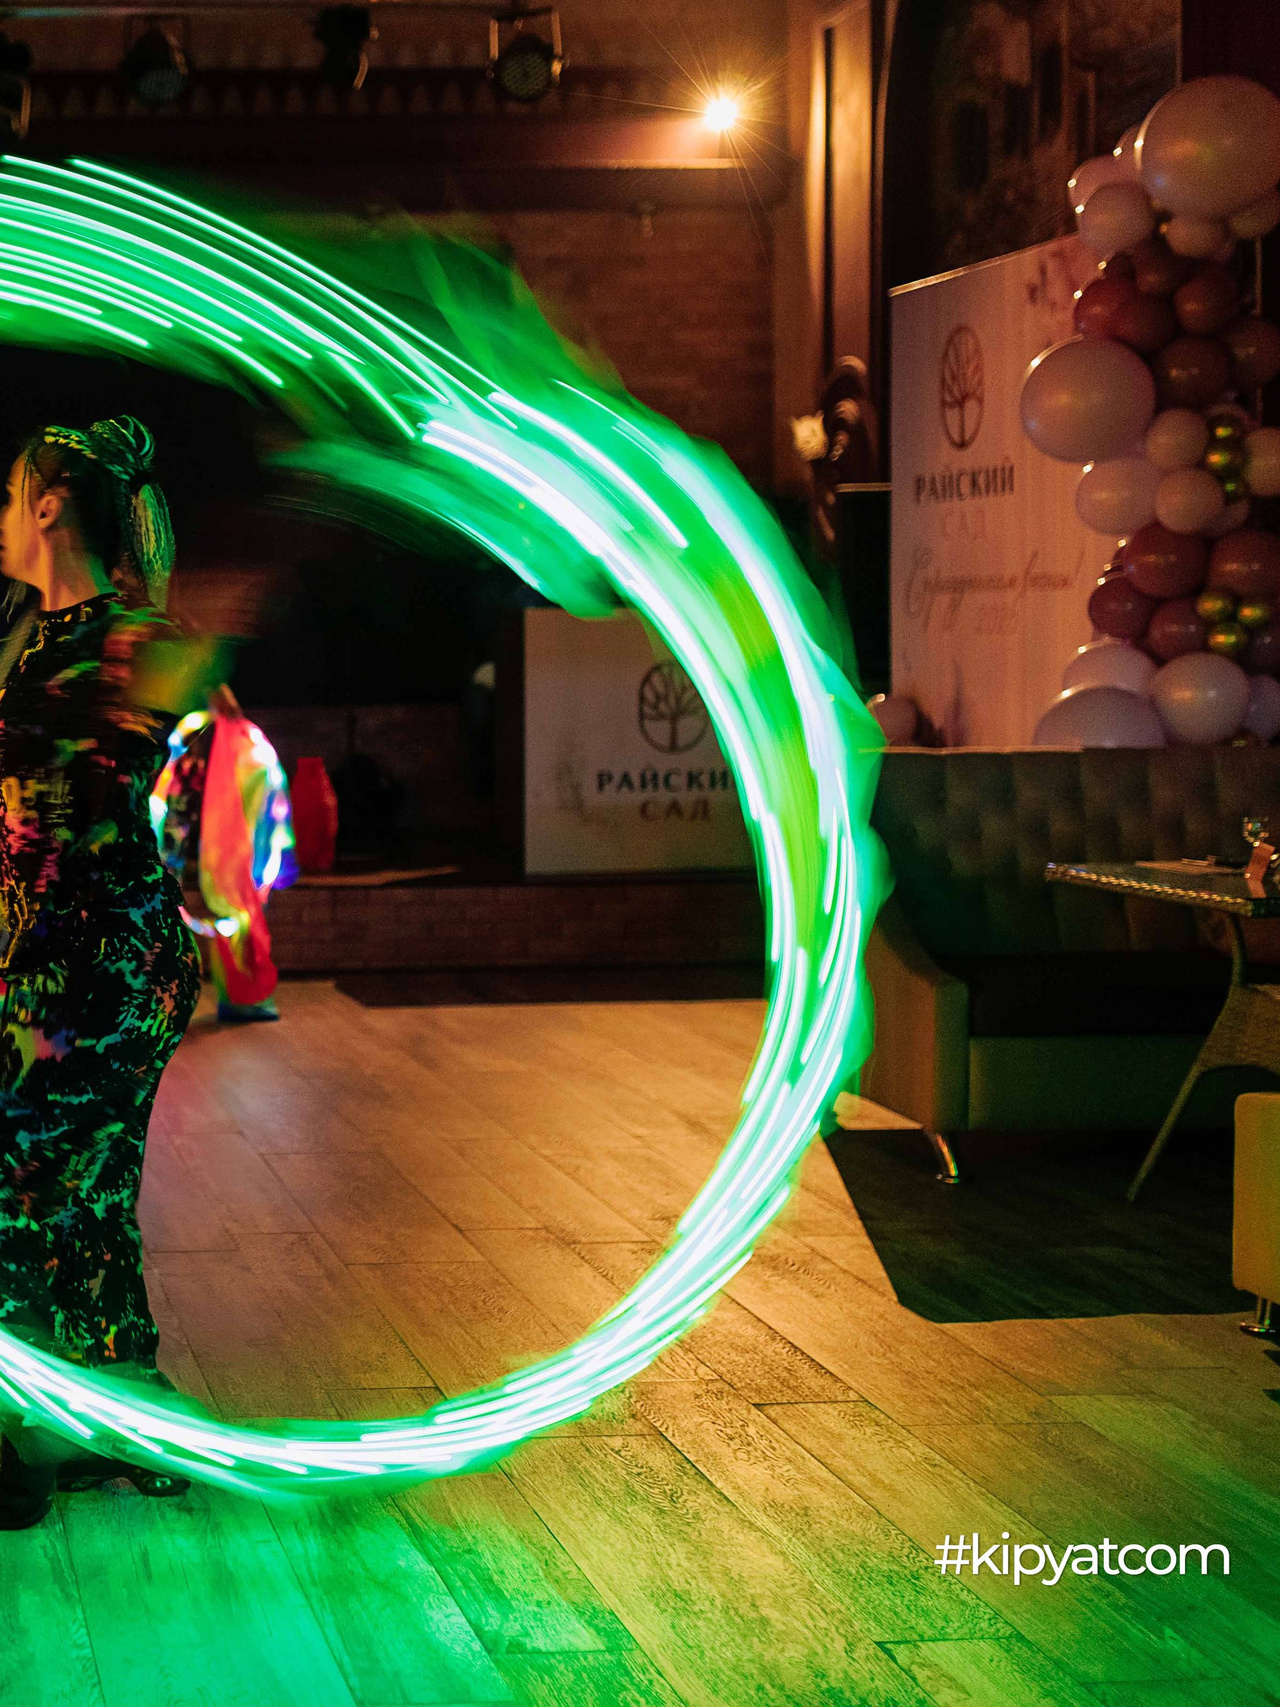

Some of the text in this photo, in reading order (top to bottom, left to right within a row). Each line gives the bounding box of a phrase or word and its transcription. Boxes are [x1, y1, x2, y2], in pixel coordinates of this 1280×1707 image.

[914, 457, 1015, 505] РАЙСКИЙ
[942, 509, 987, 540] САД
[596, 764, 734, 793] РАЙСКИ
[638, 798, 712, 822] САД
